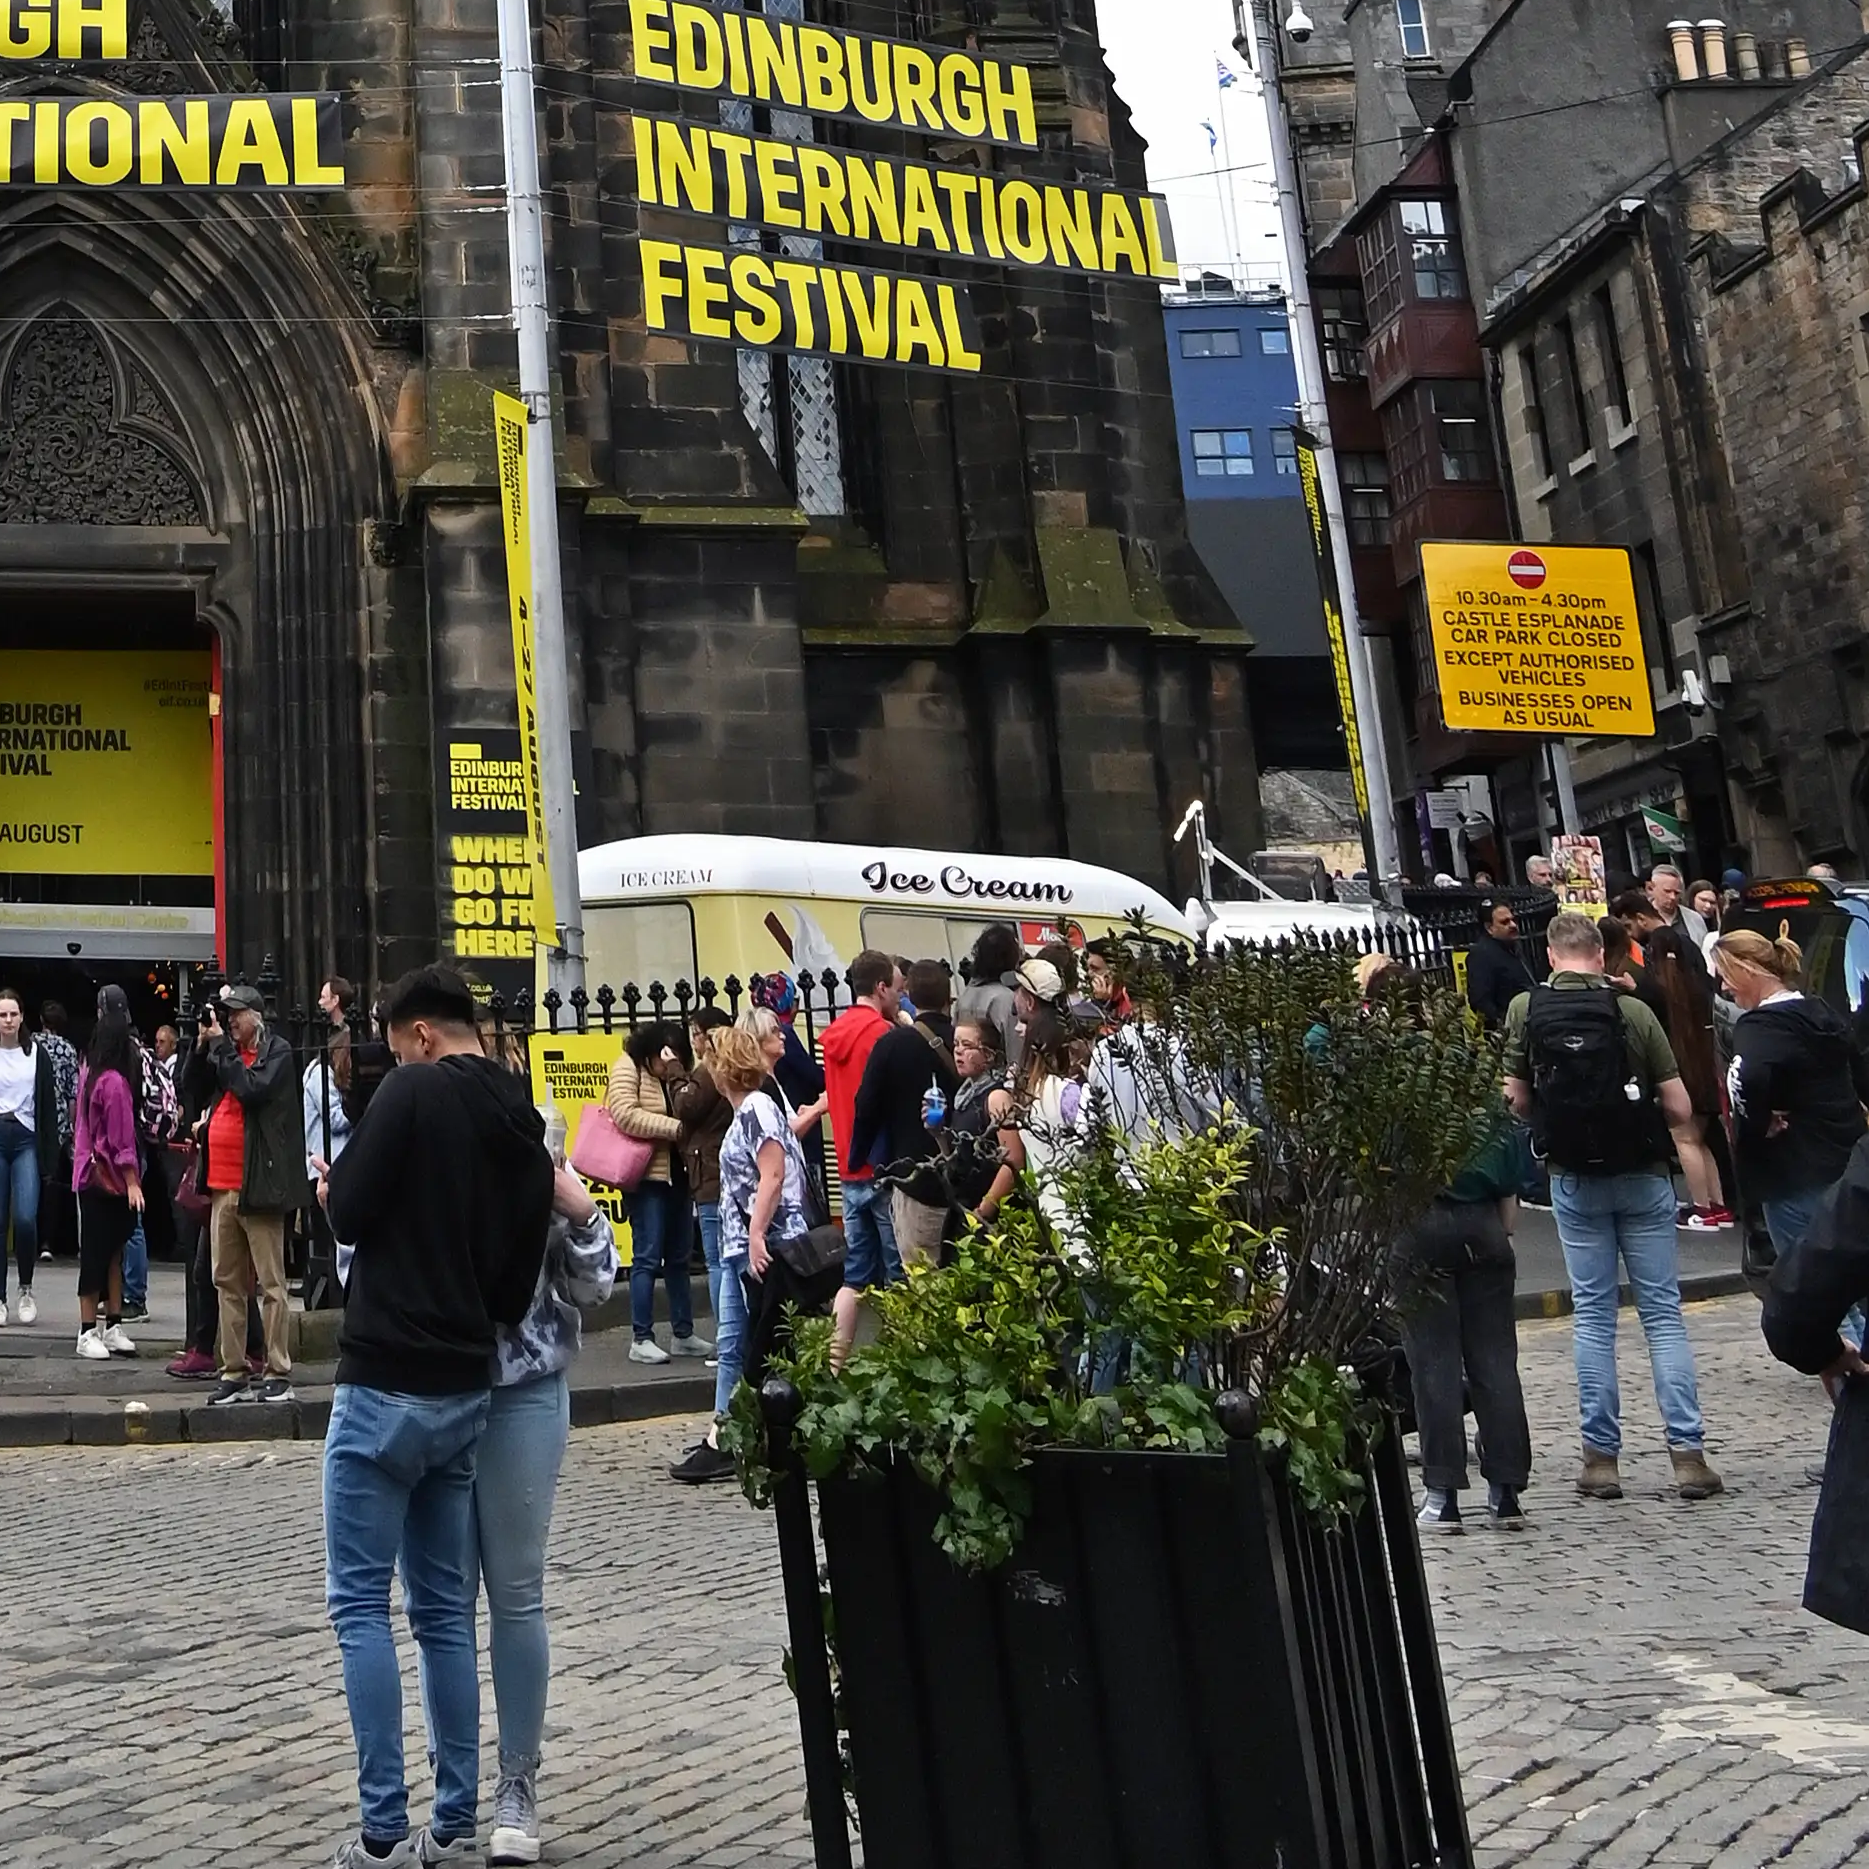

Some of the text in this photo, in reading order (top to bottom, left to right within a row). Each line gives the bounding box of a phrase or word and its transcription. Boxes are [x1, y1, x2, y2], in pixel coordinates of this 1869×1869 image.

[632, 117, 1178, 277] INTERNATIONAL
[639, 241, 981, 371] FESTIVAL
[1457, 591, 1527, 607] 10.30am
[1541, 593, 1606, 610] 4.30pm
[1443, 610, 1625, 630] CASTLE ESPLANADE
[1451, 628, 1622, 648] CAR PARK CLOSED
[1444, 650, 1634, 670] EXCEPT AUTHORISED
[1499, 669, 1586, 686] VEHICLES
[1459, 690, 1632, 711] BUSINESSES OPEN
[1503, 710, 1594, 727] AS USUAL
[450, 761, 525, 776] EDINBUR
[526, 704, 546, 873] AUGUST
[452, 794, 527, 811] FESTIVAL
[451, 835, 529, 863] WHE
[452, 866, 533, 895] DO W
[620, 868, 713, 887] ICE CREAM
[861, 861, 1073, 904] Ice Cream
[453, 898, 535, 926] GO FR
[544, 1063, 607, 1074] EDINBURGH
[545, 1075, 609, 1087] INTERNATIO
[552, 1087, 596, 1099] ESTIVAL
